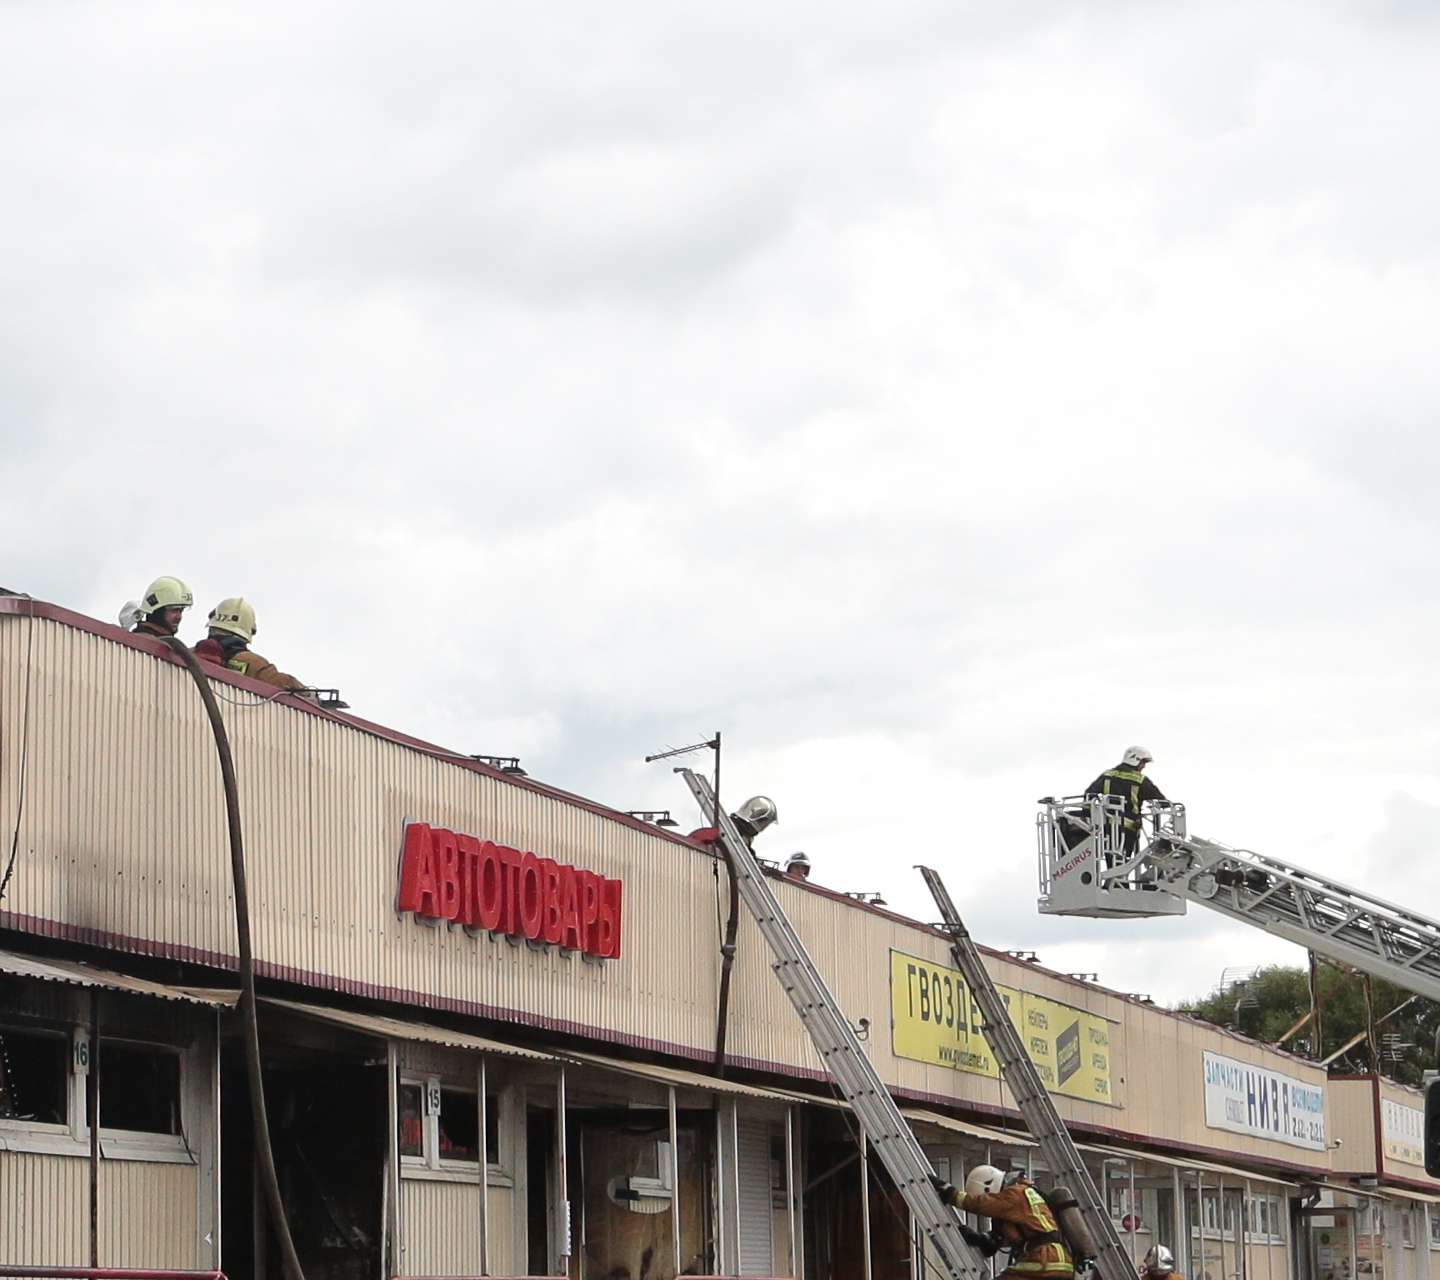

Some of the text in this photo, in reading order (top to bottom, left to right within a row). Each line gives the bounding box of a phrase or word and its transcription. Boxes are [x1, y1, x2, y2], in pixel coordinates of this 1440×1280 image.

[1052, 847, 1093, 881] MAGIRUS
[399, 822, 622, 960] АВТОТОВАРЫ
[75, 1040, 88, 1066] 16
[428, 1089, 440, 1109] 15
